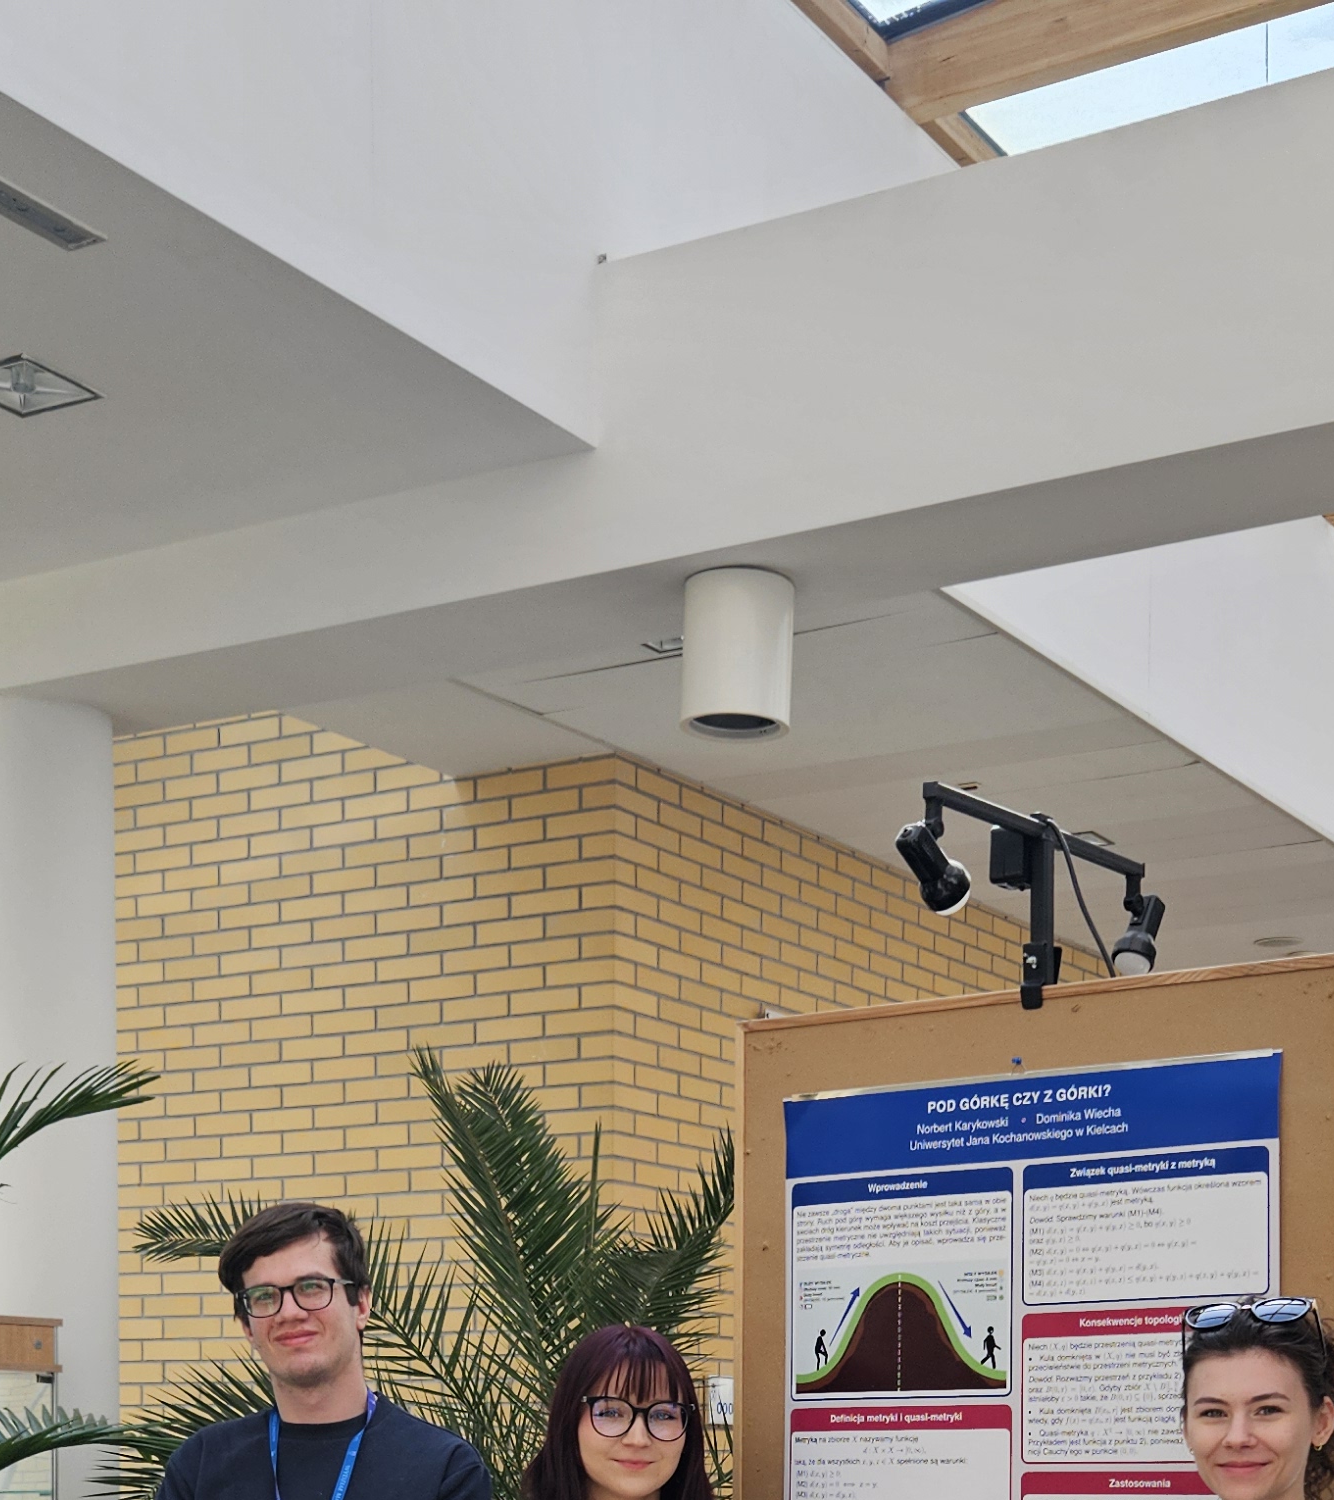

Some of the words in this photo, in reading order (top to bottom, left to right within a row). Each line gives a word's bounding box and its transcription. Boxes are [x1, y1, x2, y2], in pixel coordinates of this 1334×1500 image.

[928, 1100, 956, 1114] POD
[959, 1094, 1009, 1110] GÓRKĘ
[1013, 1091, 1040, 1105] CZY
[1043, 1090, 1052, 1102] Z
[1056, 1084, 1111, 1101] GÓRKI?
[917, 1121, 952, 1134] Norbert
[955, 1117, 1008, 1132] Karykowski
[1036, 1110, 1081, 1124] Dominika
[1084, 1107, 1121, 1119] Wiecha
[910, 1137, 964, 1150] Uniwersytet
[966, 1135, 989, 1146] Jana
[992, 1128, 1073, 1144] Kochanowskiego
[1075, 1128, 1084, 1136] w
[1087, 1122, 1128, 1135] Kielcach
[1070, 1166, 1105, 1178] Związek
[1107, 1160, 1169, 1177] quasi-metryki
[1178, 1158, 1215, 1170] metryką
[868, 1180, 928, 1194] Wprowadzenie
[1079, 1316, 1142, 1328] Konsekwencje
[1145, 1315, 1182, 1326] topologi
[831, 1414, 864, 1424] Definicja
[867, 1413, 897, 1424] metryki
[900, 1414, 902, 1422] i
[904, 1412, 962, 1423] quasi-metryki
[1109, 1479, 1171, 1488] Zastosowania
